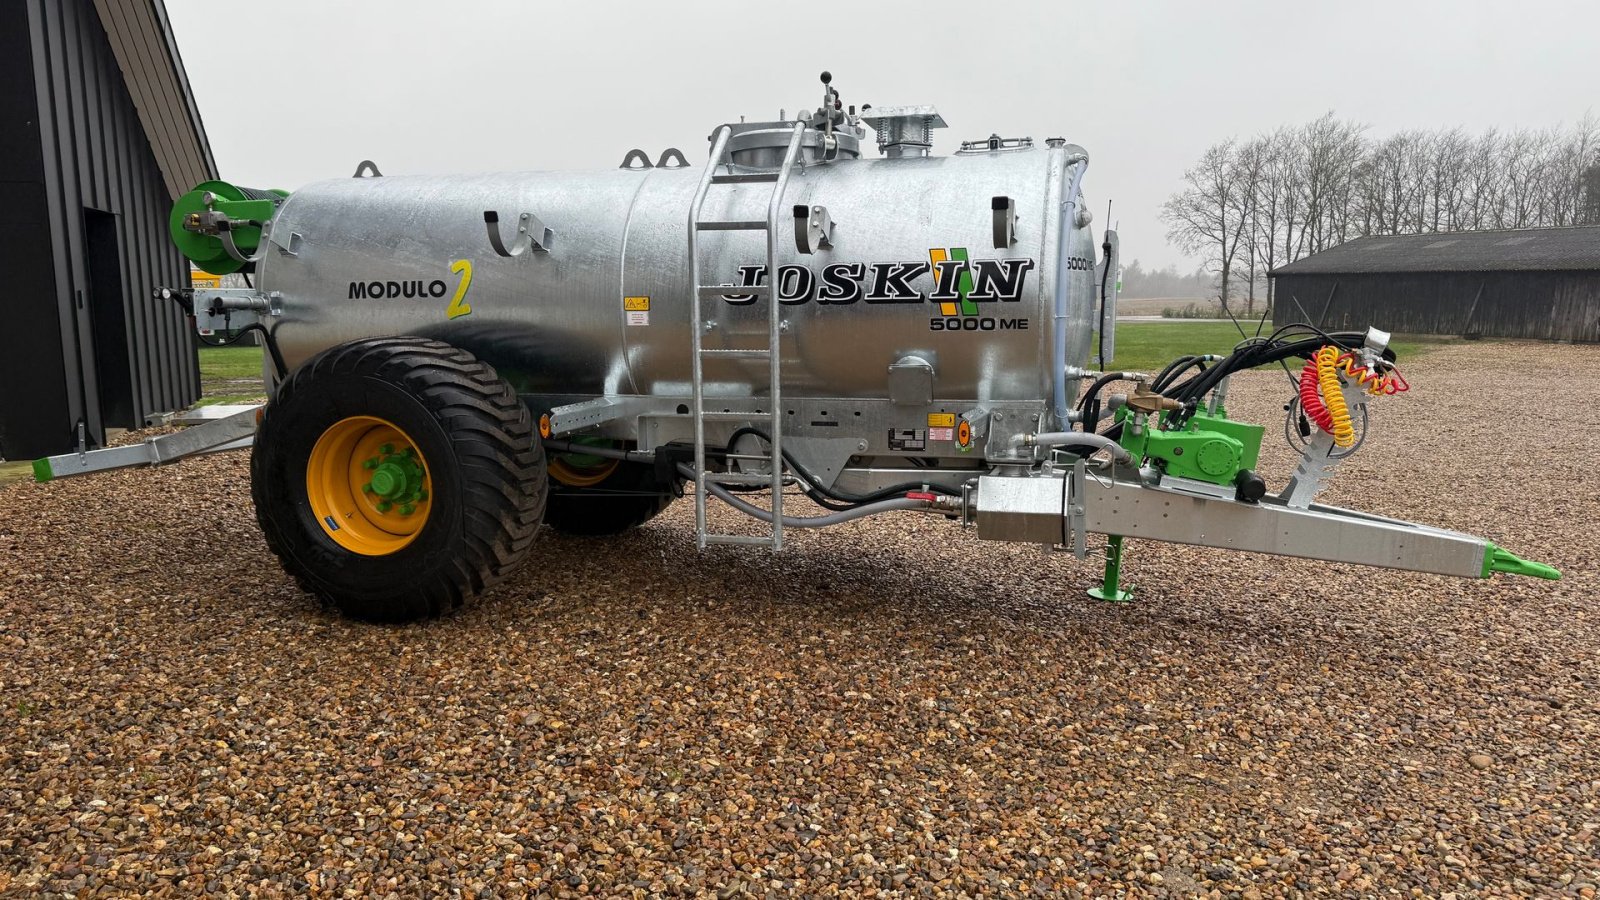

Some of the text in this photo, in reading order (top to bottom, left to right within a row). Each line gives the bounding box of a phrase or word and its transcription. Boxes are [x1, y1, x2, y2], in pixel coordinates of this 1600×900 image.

[348, 259, 473, 320] MODULO 2
[720, 258, 1034, 305] JOSKIN
[930, 318, 1029, 330] 5000 ME
